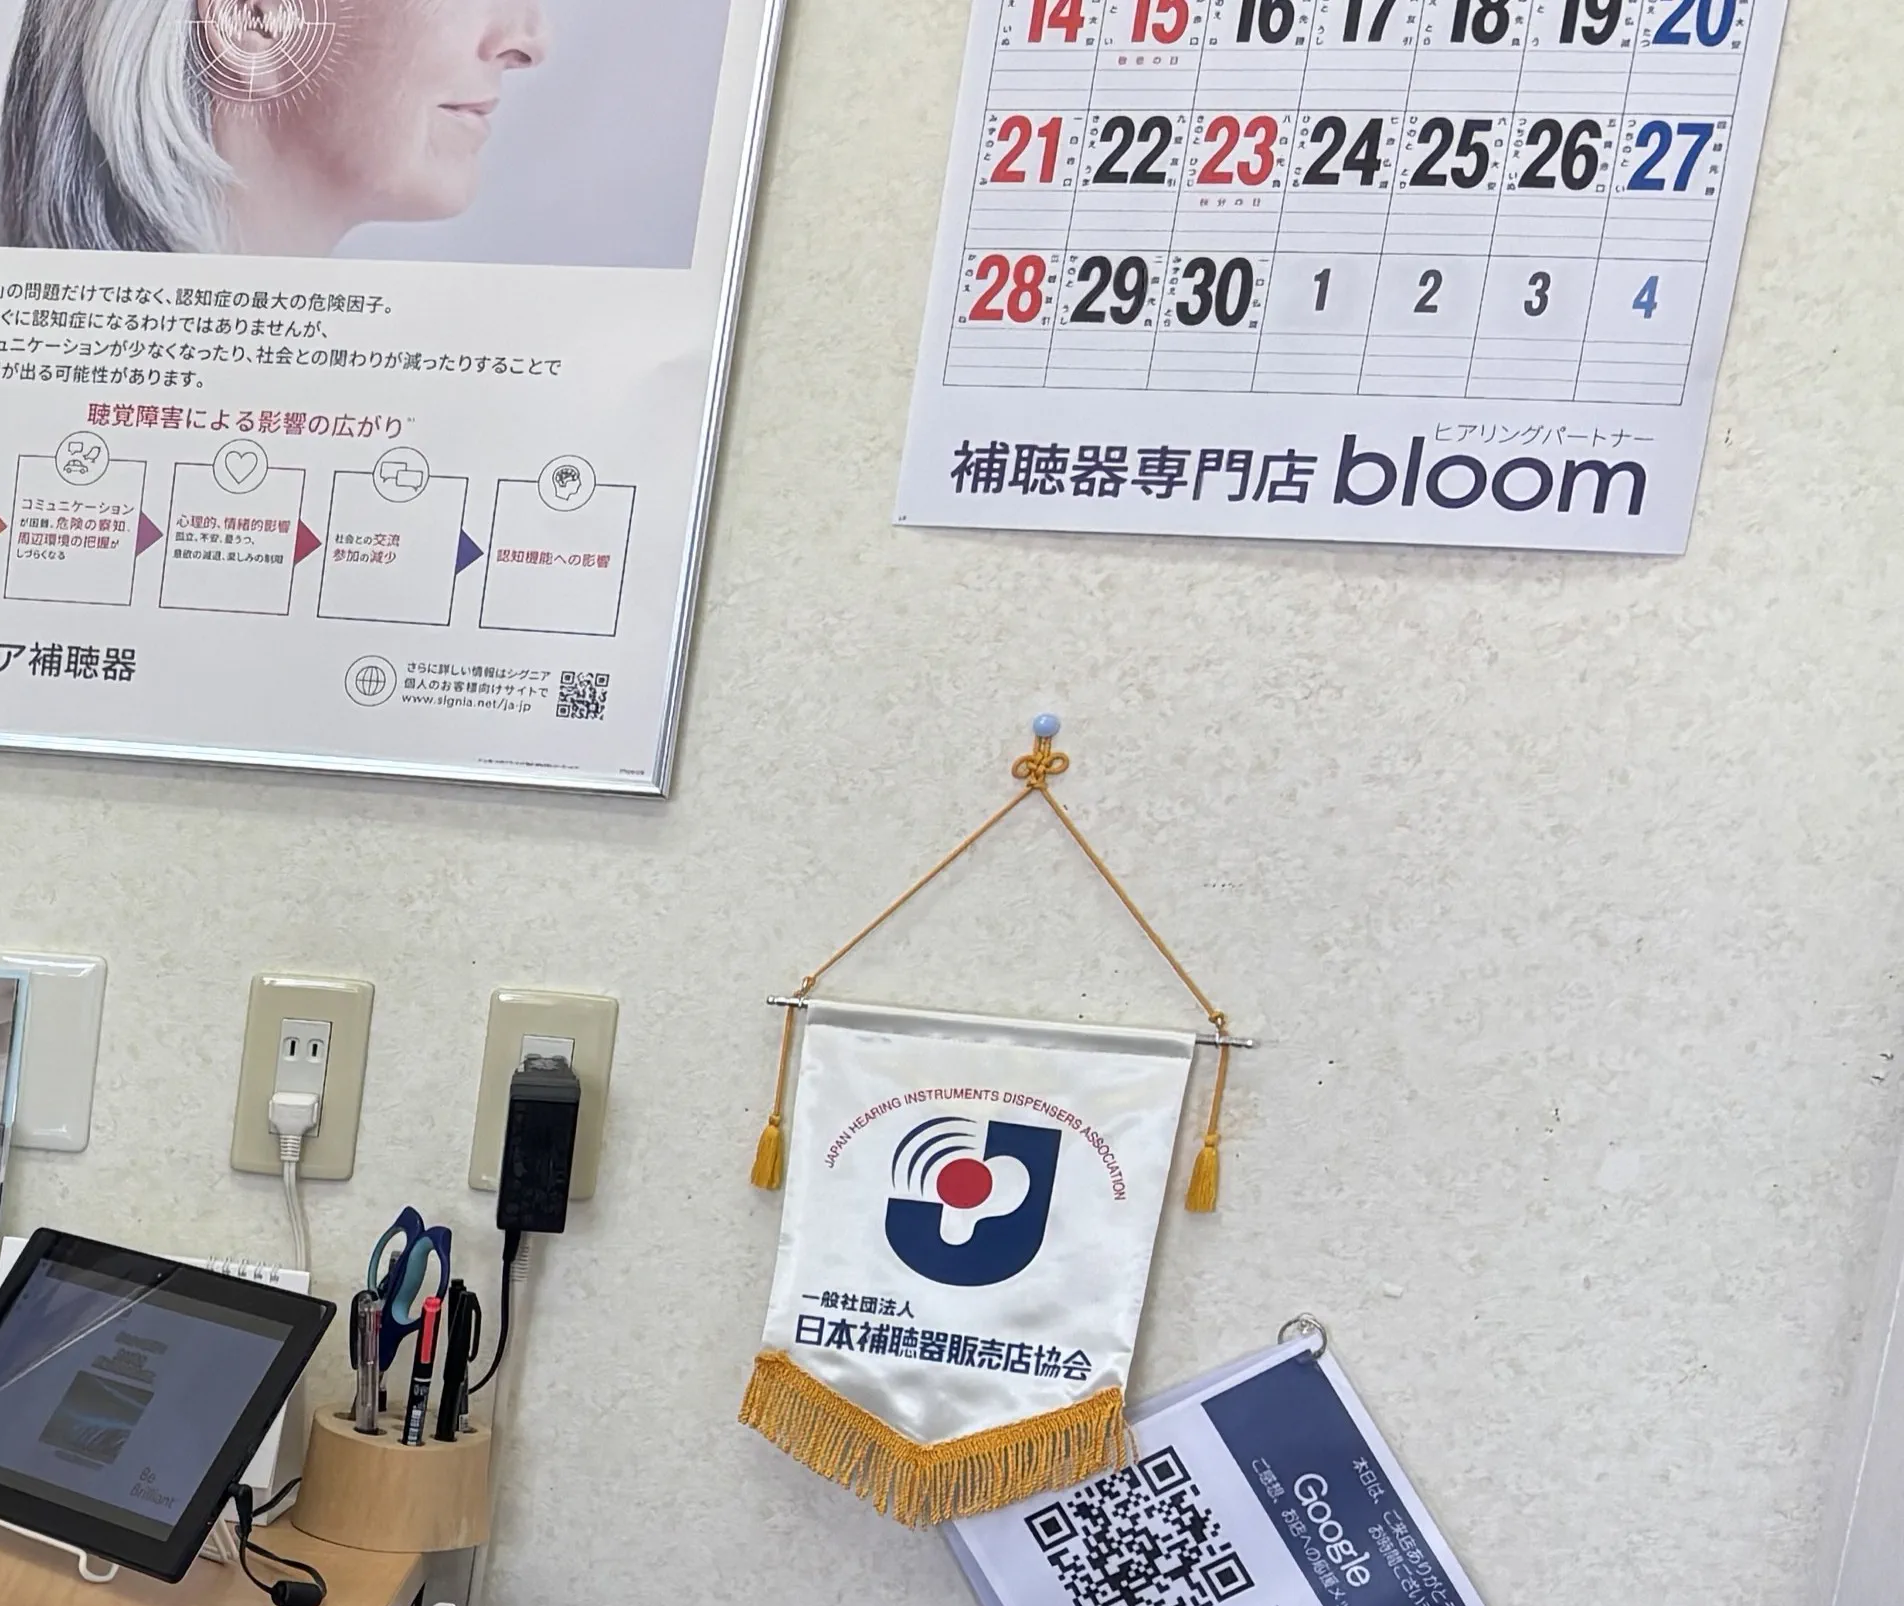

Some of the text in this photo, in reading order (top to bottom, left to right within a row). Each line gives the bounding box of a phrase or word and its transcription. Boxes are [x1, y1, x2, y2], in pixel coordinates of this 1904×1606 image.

[1028, 0, 1085, 43] 14
[1131, 0, 1190, 45] 15
[1236, 0, 1295, 44] 16
[1342, 0, 1395, 42] 17
[1450, 0, 1510, 44] 18
[1559, 0, 1622, 45] 19
[1652, 0, 1736, 47] 20
[990, 115, 1063, 184] 21
[1092, 115, 1173, 185] 22
[1196, 115, 1278, 186] 23
[1302, 115, 1384, 187] 24
[1409, 116, 1493, 189] 25
[1517, 118, 1602, 191] 26
[1626, 120, 1715, 192] 27
[968, 254, 1047, 323] 28
[1069, 255, 1149, 325] 29
[1176, 257, 1254, 327] 30
[1313, 268, 1331, 312] 1
[1413, 269, 1443, 314] 2
[1524, 271, 1550, 318] 3
[1632, 275, 1657, 320] 4
[87, 402, 402, 440] 聴覚障害による影響の広がり
[1434, 422, 1656, 448] ヒアリングパートナー
[950, 434, 1650, 516] 補聴器専門店 bloom
[21, 498, 135, 515] コミュニケーション
[176, 514, 291, 534] 心理的、情緒的影響
[16, 549, 66, 560] しづらくなる
[332, 548, 397, 564] 参加の減少
[334, 533, 400, 548] 社会との交流
[496, 549, 611, 569] 認知機能への影響
[404, 678, 549, 698] 個人のお客様向けサイトで
[406, 662, 551, 682] さらに詳しい情報はシグニア
[823, 1088, 1127, 1201] JAPAN HEARING INSTRUMENTS DISPENSERS ASSOCIATION
[802, 1291, 915, 1319] 一般社団法人
[795, 1315, 1093, 1382] 日本補聴器販売店協会
[1292, 1471, 1373, 1590] Google
